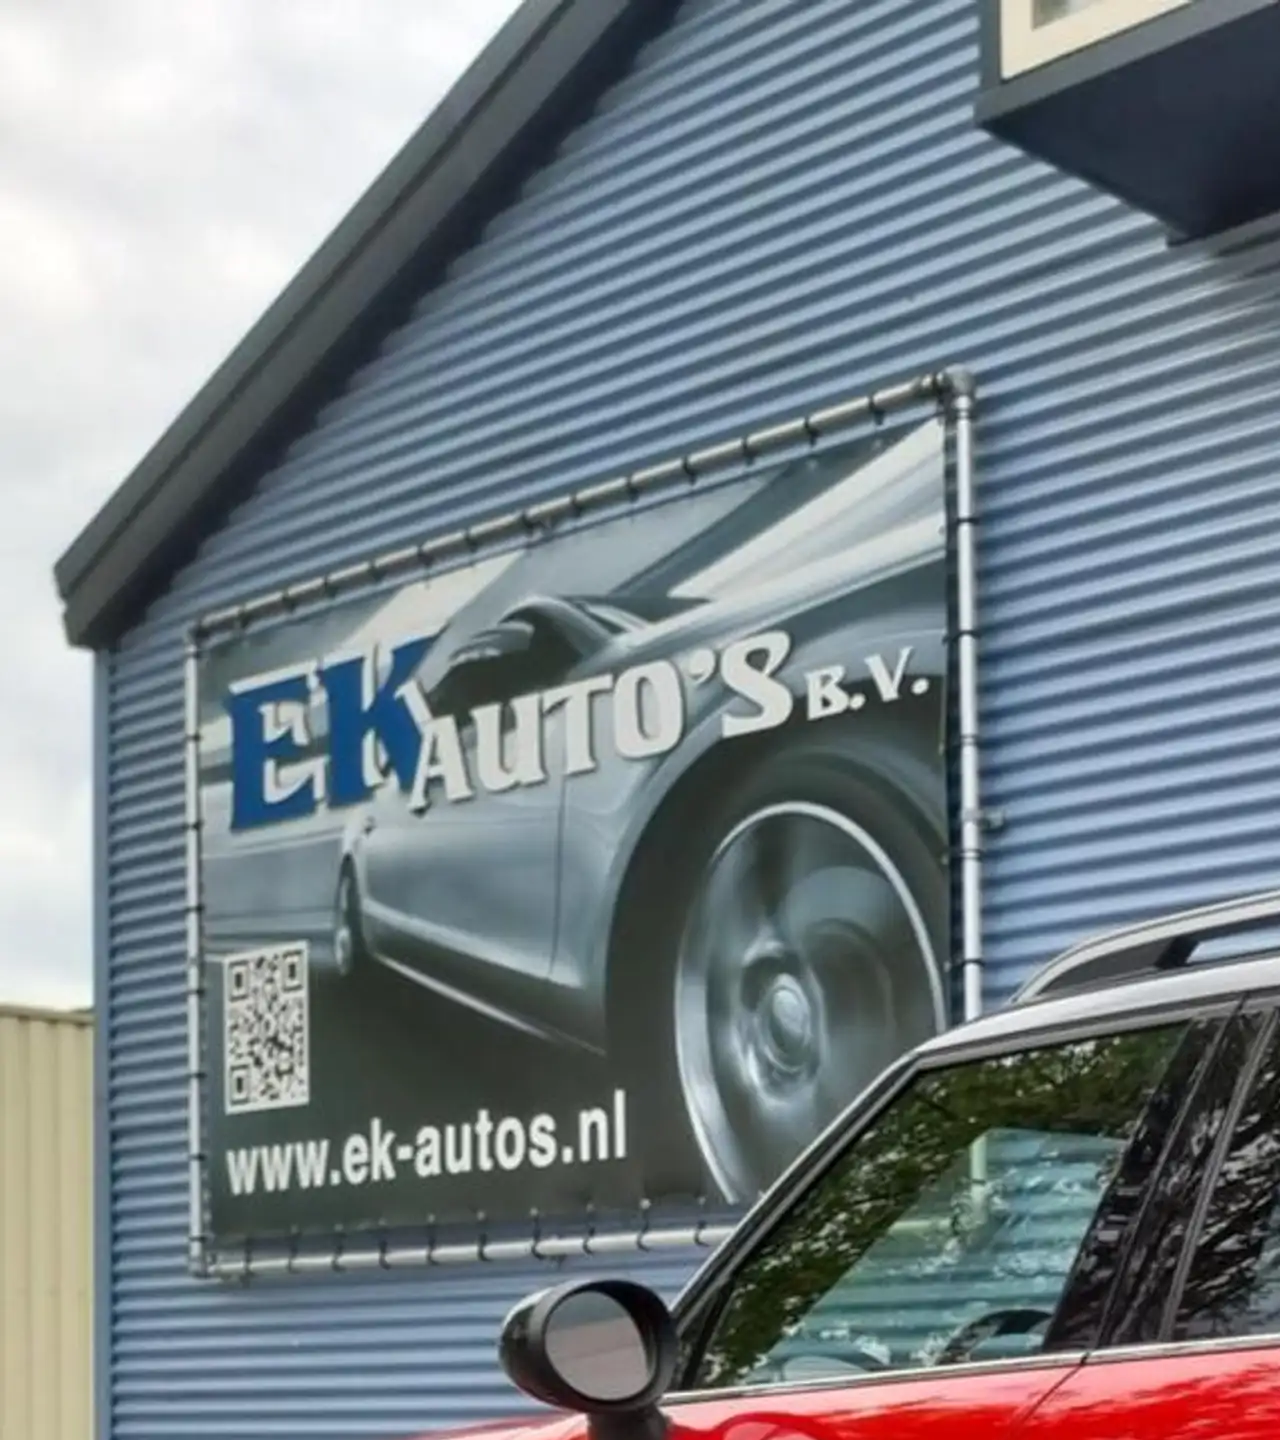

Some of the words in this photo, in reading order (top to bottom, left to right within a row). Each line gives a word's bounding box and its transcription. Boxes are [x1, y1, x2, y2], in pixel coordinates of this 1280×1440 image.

[228, 635, 440, 833] EK
[406, 630, 794, 816] AUTO'S
[804, 646, 930, 721] B.V.
[226, 1088, 627, 1196] www.ek-autos.nl
